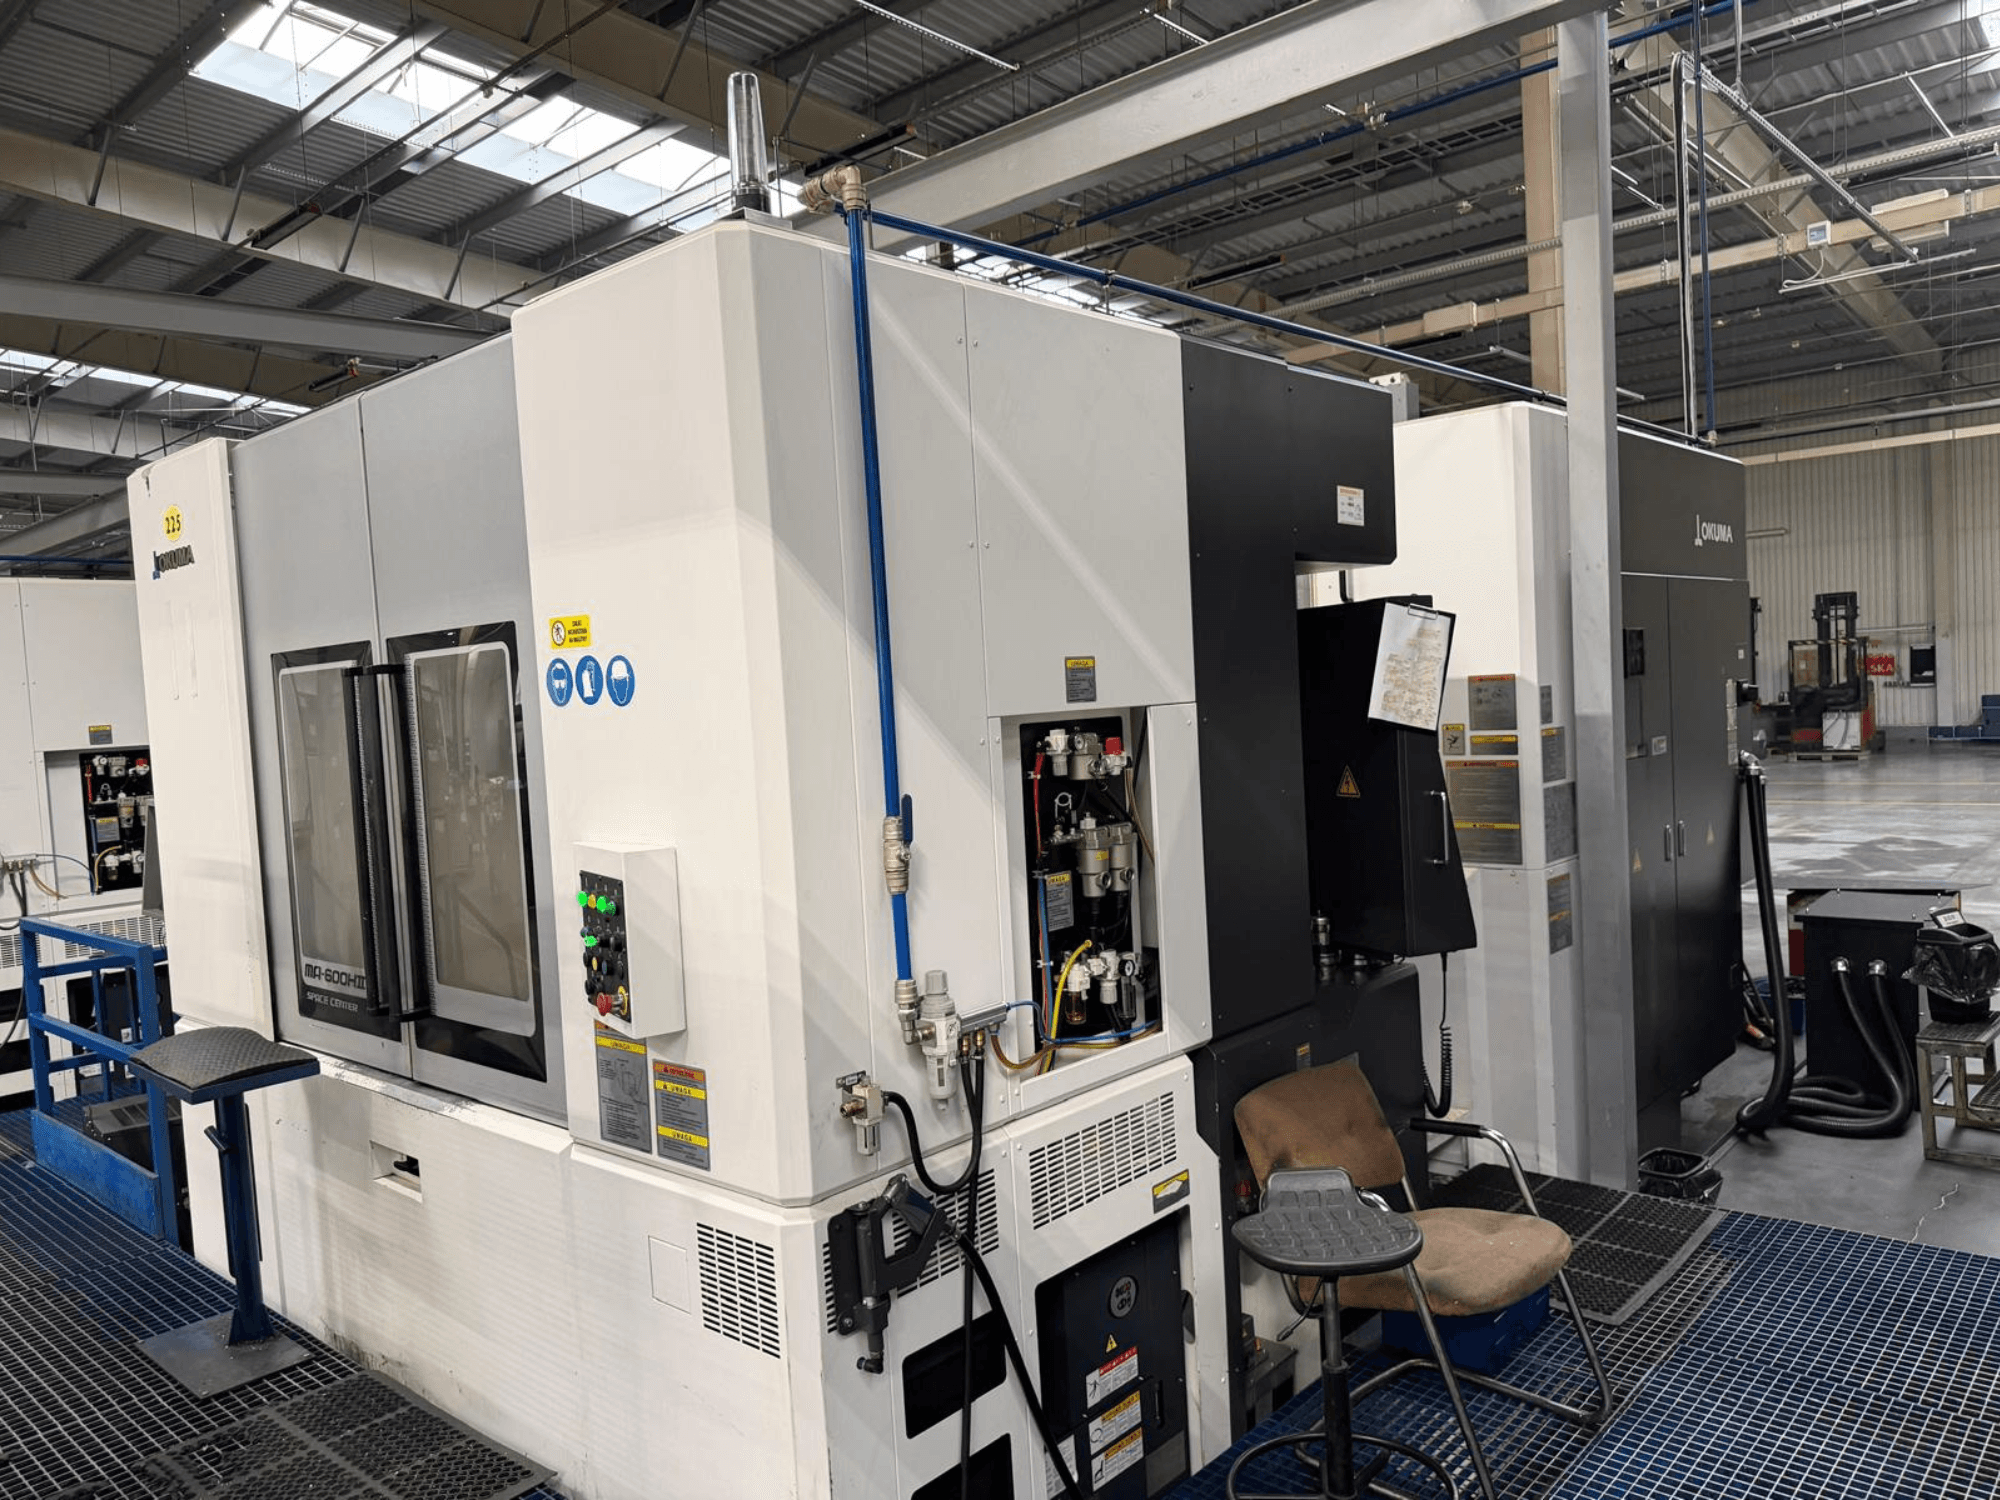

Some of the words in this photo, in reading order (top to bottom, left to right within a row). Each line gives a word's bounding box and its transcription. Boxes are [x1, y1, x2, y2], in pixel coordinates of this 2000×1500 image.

[1701, 521, 1733, 543] OKUMA
[157, 545, 195, 573] OKUMA
[306, 991, 329, 1005] SPACE
[329, 997, 359, 1013] CENTER
